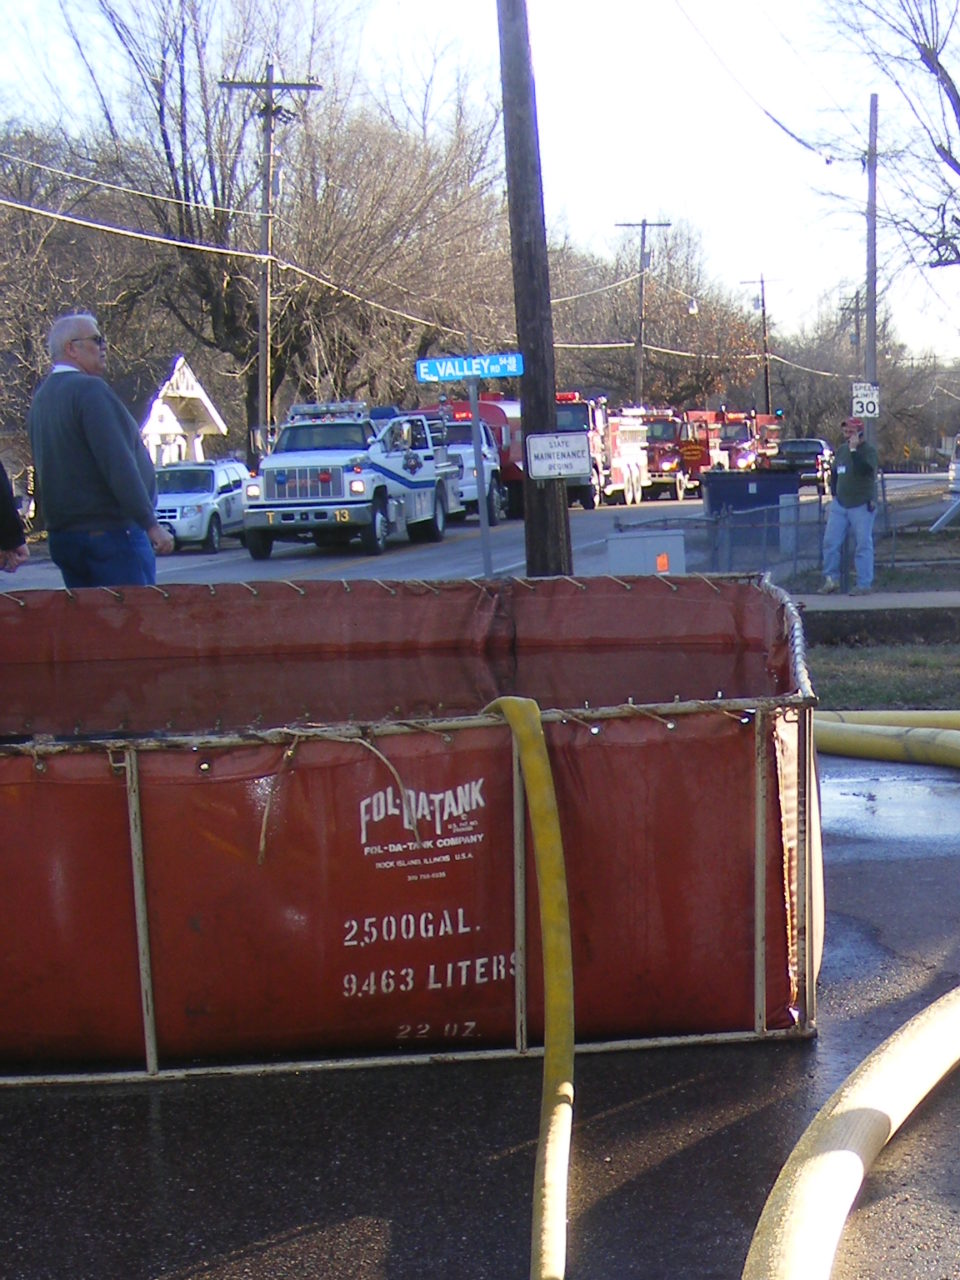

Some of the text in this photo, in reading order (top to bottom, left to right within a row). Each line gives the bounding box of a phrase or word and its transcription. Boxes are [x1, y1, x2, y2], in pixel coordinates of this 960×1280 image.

[436, 358, 490, 377] VALLEY
[490, 364, 501, 374] RD
[855, 401, 876, 414] 30
[549, 440, 569, 449] STATE
[534, 449, 586, 460] MAINTENANCE
[548, 462, 574, 471] BEGINS
[265, 509, 350, 524] T 13
[436, 833, 485, 848] COMPANY
[343, 967, 415, 998] 9,463
[396, 1023, 430, 1039] 22
